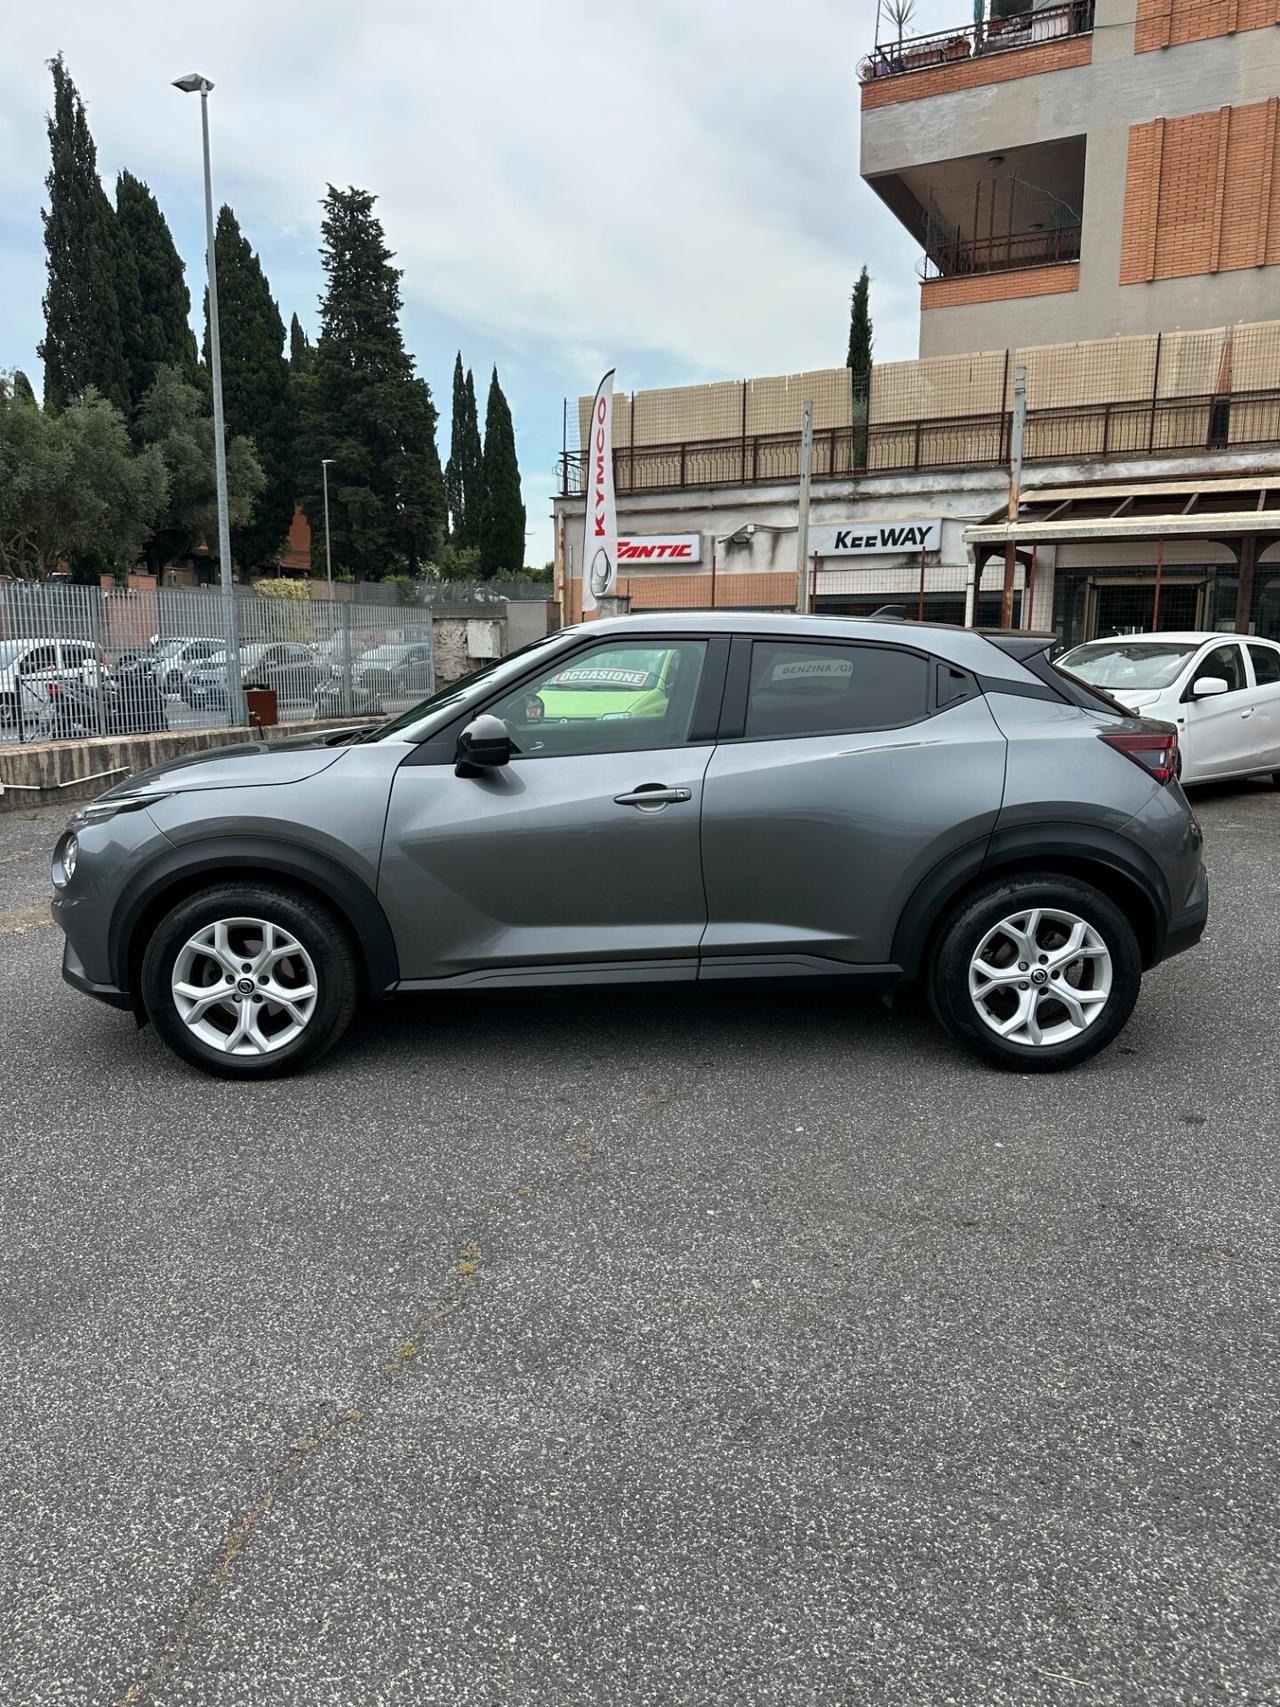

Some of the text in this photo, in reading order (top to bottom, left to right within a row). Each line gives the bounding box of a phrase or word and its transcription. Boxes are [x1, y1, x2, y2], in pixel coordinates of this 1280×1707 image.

[595, 396, 606, 536] KYMCO
[617, 541, 692, 558] FANTIC
[560, 670, 643, 683] OCCASIONE
[782, 664, 832, 674] BENZINA
